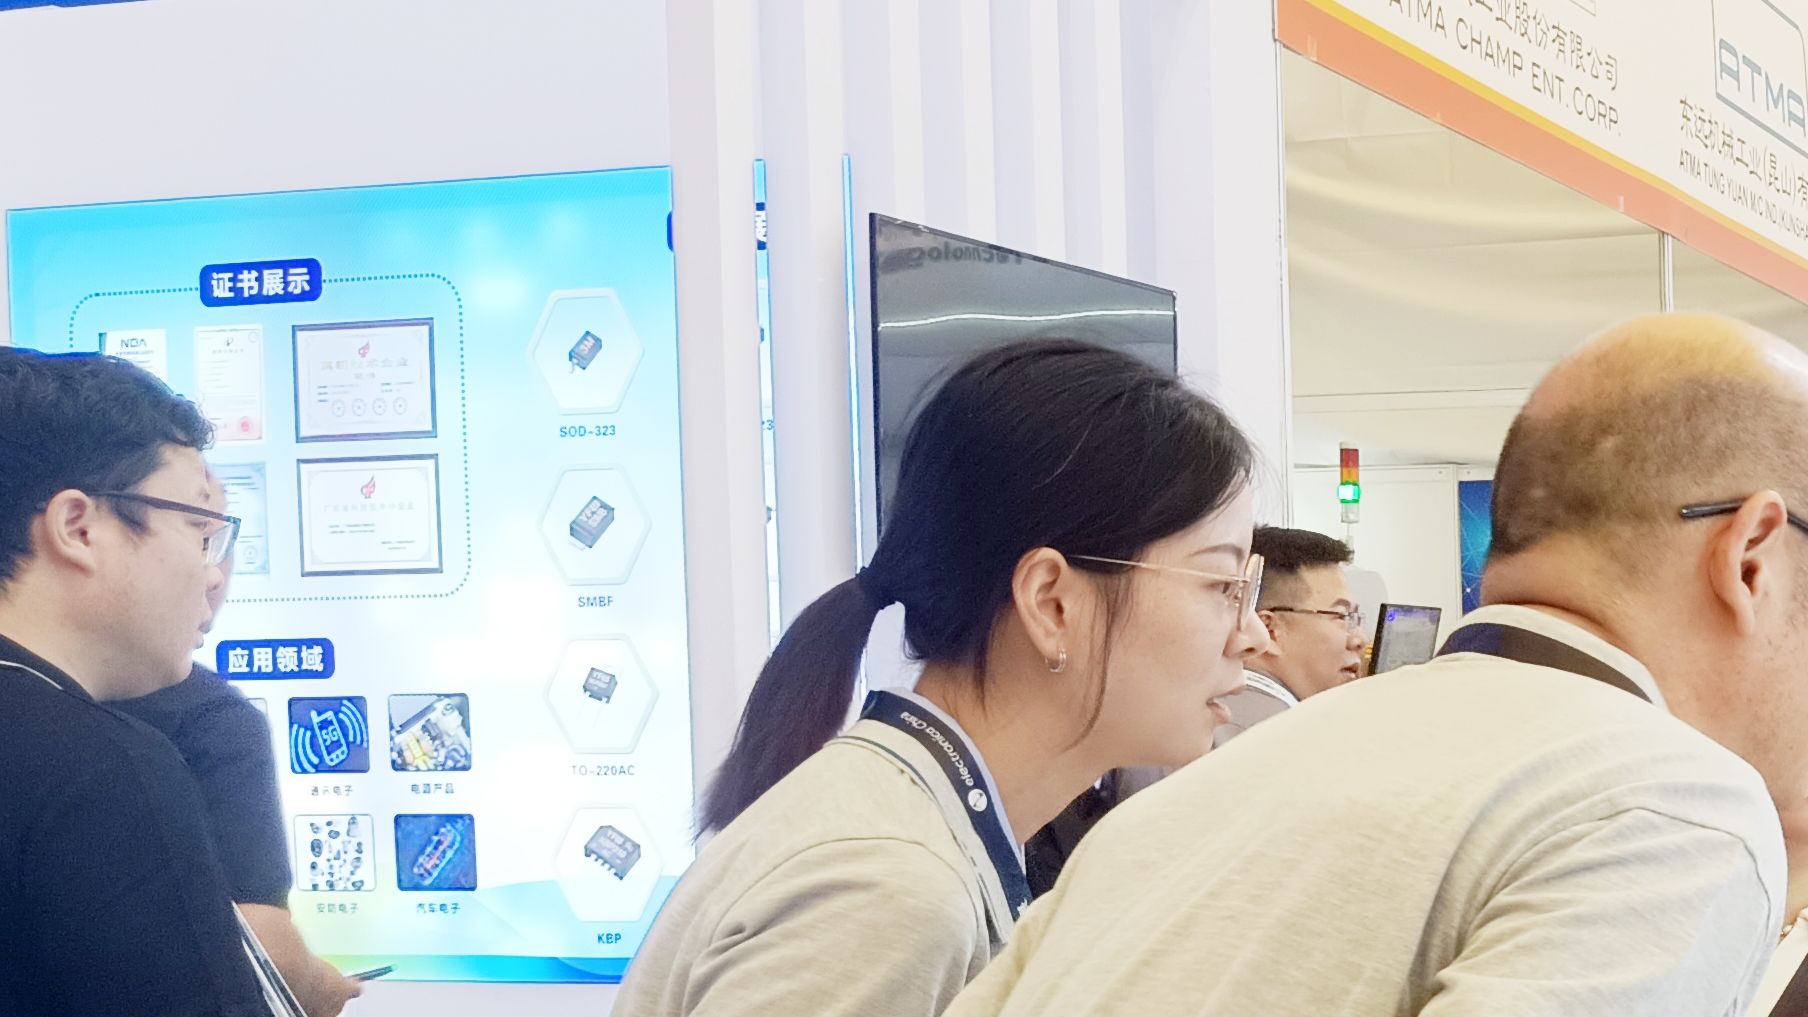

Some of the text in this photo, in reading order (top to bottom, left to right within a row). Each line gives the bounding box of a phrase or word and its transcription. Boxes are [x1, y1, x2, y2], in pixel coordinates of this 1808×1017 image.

[1456, 17, 1524, 78] CHAMP
[1718, 37, 1807, 138] ATMA
[1679, 147, 1702, 179] ATMA
[1703, 162, 1726, 196] TUNG
[1726, 175, 1749, 209] YUAN
[211, 267, 310, 298] 证书展示
[559, 424, 616, 438] SOD-323
[577, 595, 614, 608] SMBF
[228, 645, 324, 674] 应用领域
[571, 764, 635, 777] TO-220AC
[925, 726, 975, 787] electronica
[596, 932, 623, 945] KBP
